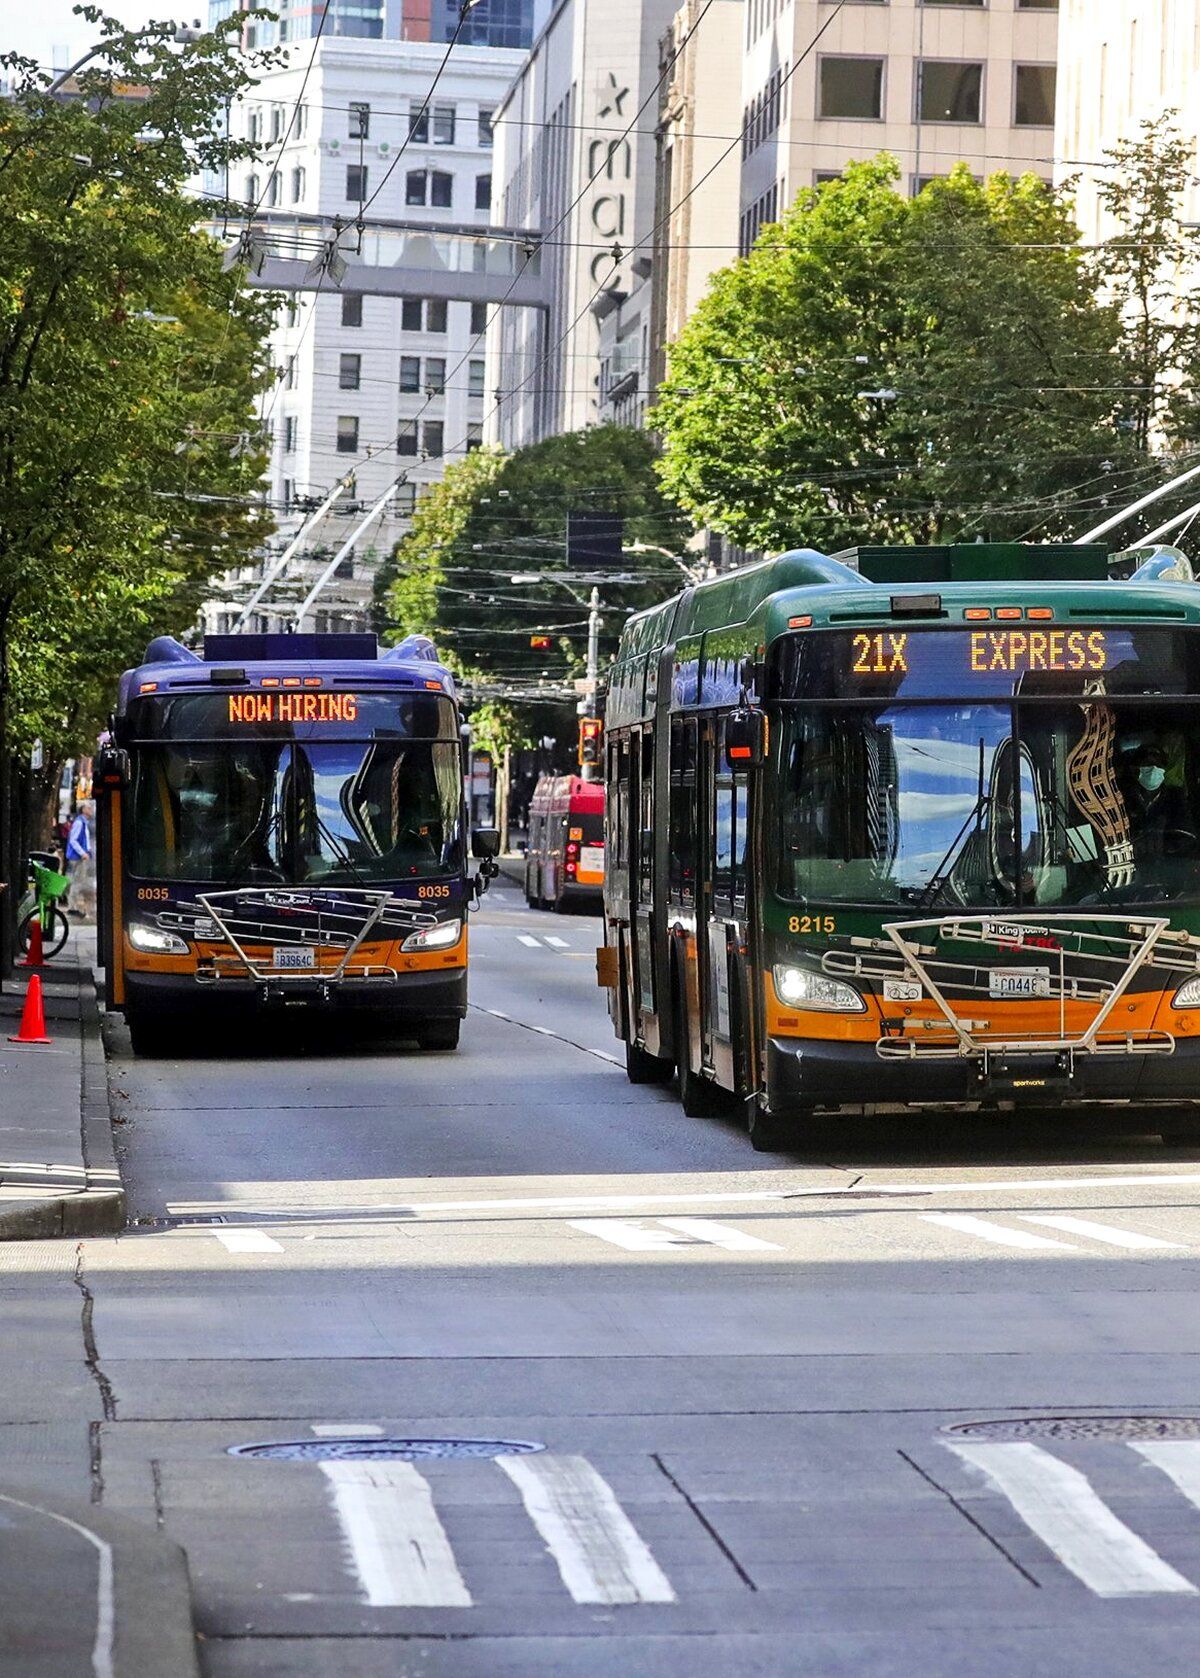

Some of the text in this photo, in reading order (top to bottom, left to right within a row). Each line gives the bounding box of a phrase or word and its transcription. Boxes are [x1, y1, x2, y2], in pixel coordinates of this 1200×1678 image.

[853, 631, 1106, 671] 21X EXPRESS
[229, 694, 356, 721] NOW HIRING
[137, 888, 169, 900] 8035
[418, 886, 450, 898] 8035
[788, 916, 836, 933] 8215
[998, 926, 1018, 936] King
[280, 955, 312, 967] B3964C
